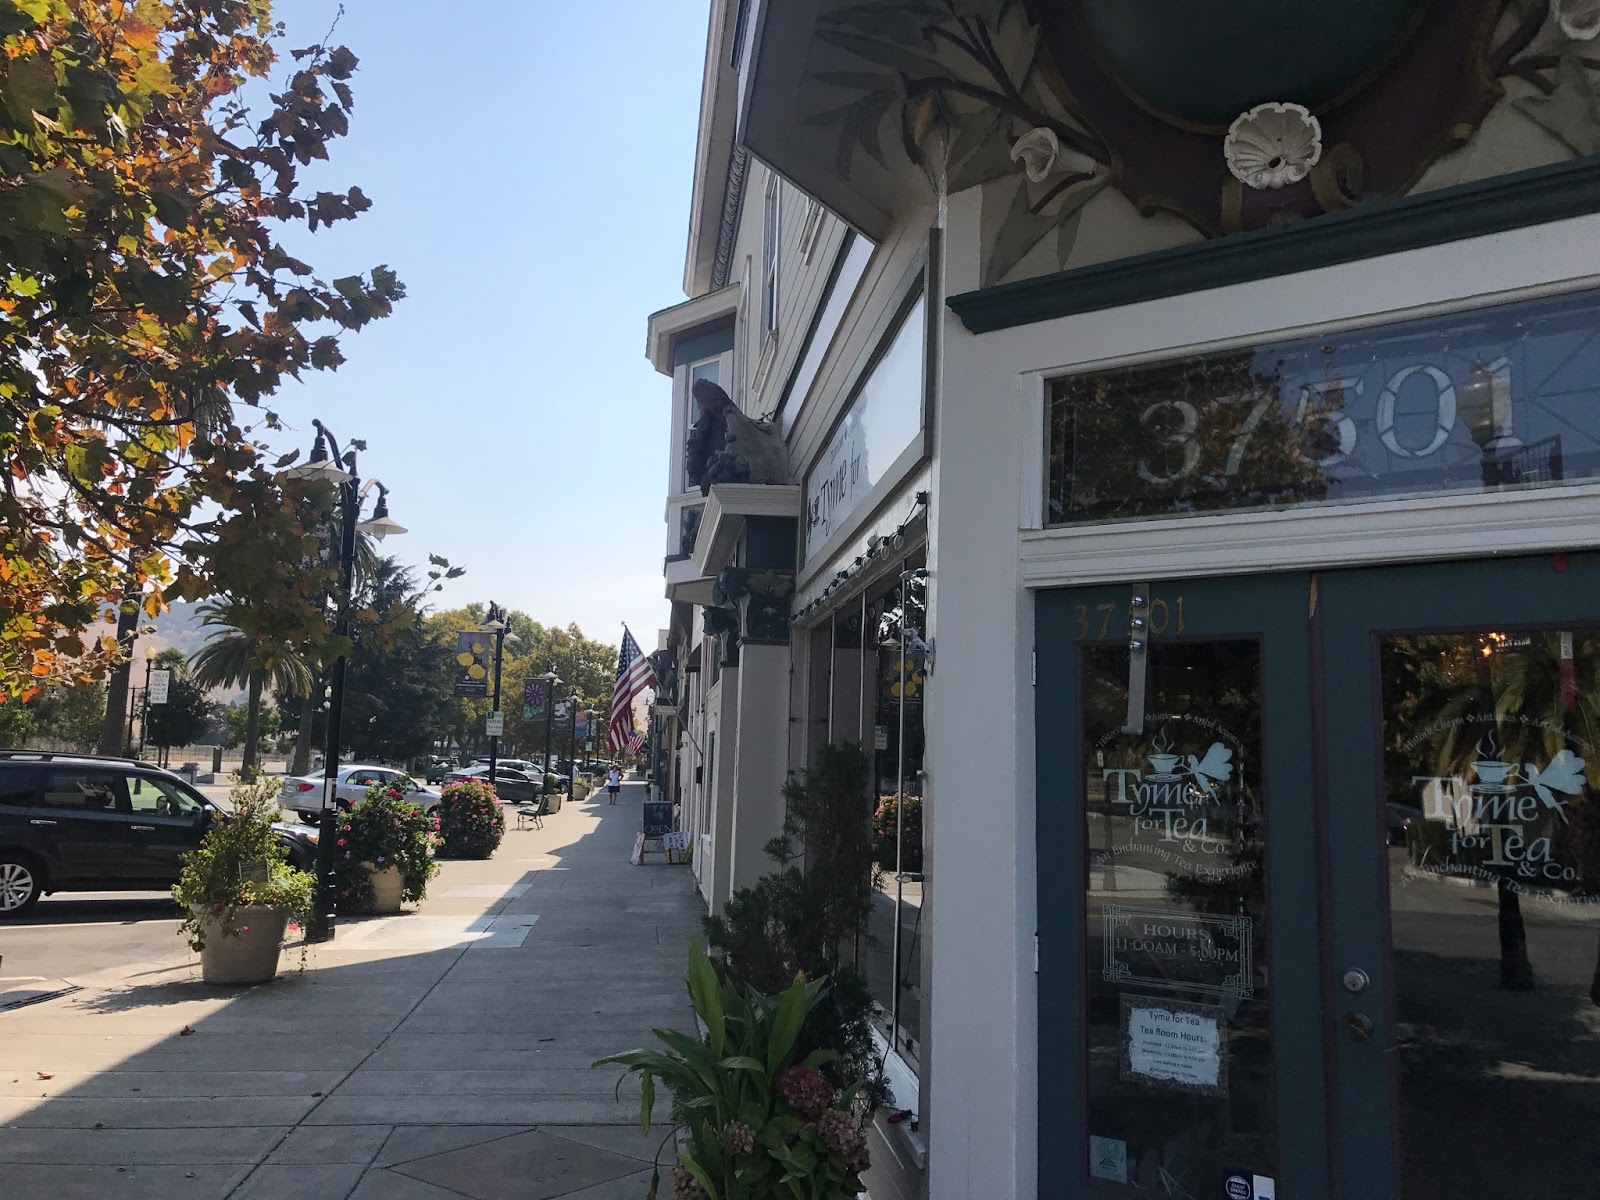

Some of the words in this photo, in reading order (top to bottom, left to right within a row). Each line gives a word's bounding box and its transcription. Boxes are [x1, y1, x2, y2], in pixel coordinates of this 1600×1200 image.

[1138, 356, 1524, 485] 37501
[821, 459, 847, 537] Tyme
[850, 441, 861, 501] for
[1074, 596, 1185, 642] 3701
[1193, 714, 1218, 729] Artful
[1475, 711, 1516, 723] Antiues
[1103, 769, 1199, 816] Tyme
[1412, 774, 1540, 831] Tyme
[645, 825, 672, 834] OPEN
[1132, 815, 1163, 836] for
[1149, 808, 1210, 843] Tea
[1182, 839, 1198, 854] &
[1201, 840, 1229, 855] Co.
[1450, 832, 1492, 855] for
[1475, 823, 1554, 866] Tea
[1096, 852, 1111, 865] An
[1112, 837, 1171, 862] Enchanting
[1173, 853, 1193, 871] Tea
[1195, 859, 1258, 879] Experience
[1517, 860, 1537, 878] &
[1543, 862, 1581, 882] Co.
[1505, 876, 1529, 897] Tea
[1143, 923, 1210, 941] HOURS
[1189, 945, 1239, 962] 5:00PM
[1149, 1010, 1171, 1022] Tyme
[1172, 1013, 1183, 1024] for
[1185, 1016, 1200, 1026] Tea
[1140, 1025, 1154, 1035] Tea
[1155, 1027, 1178, 1039] Room
[1180, 1031, 1207, 1043] Hours:
